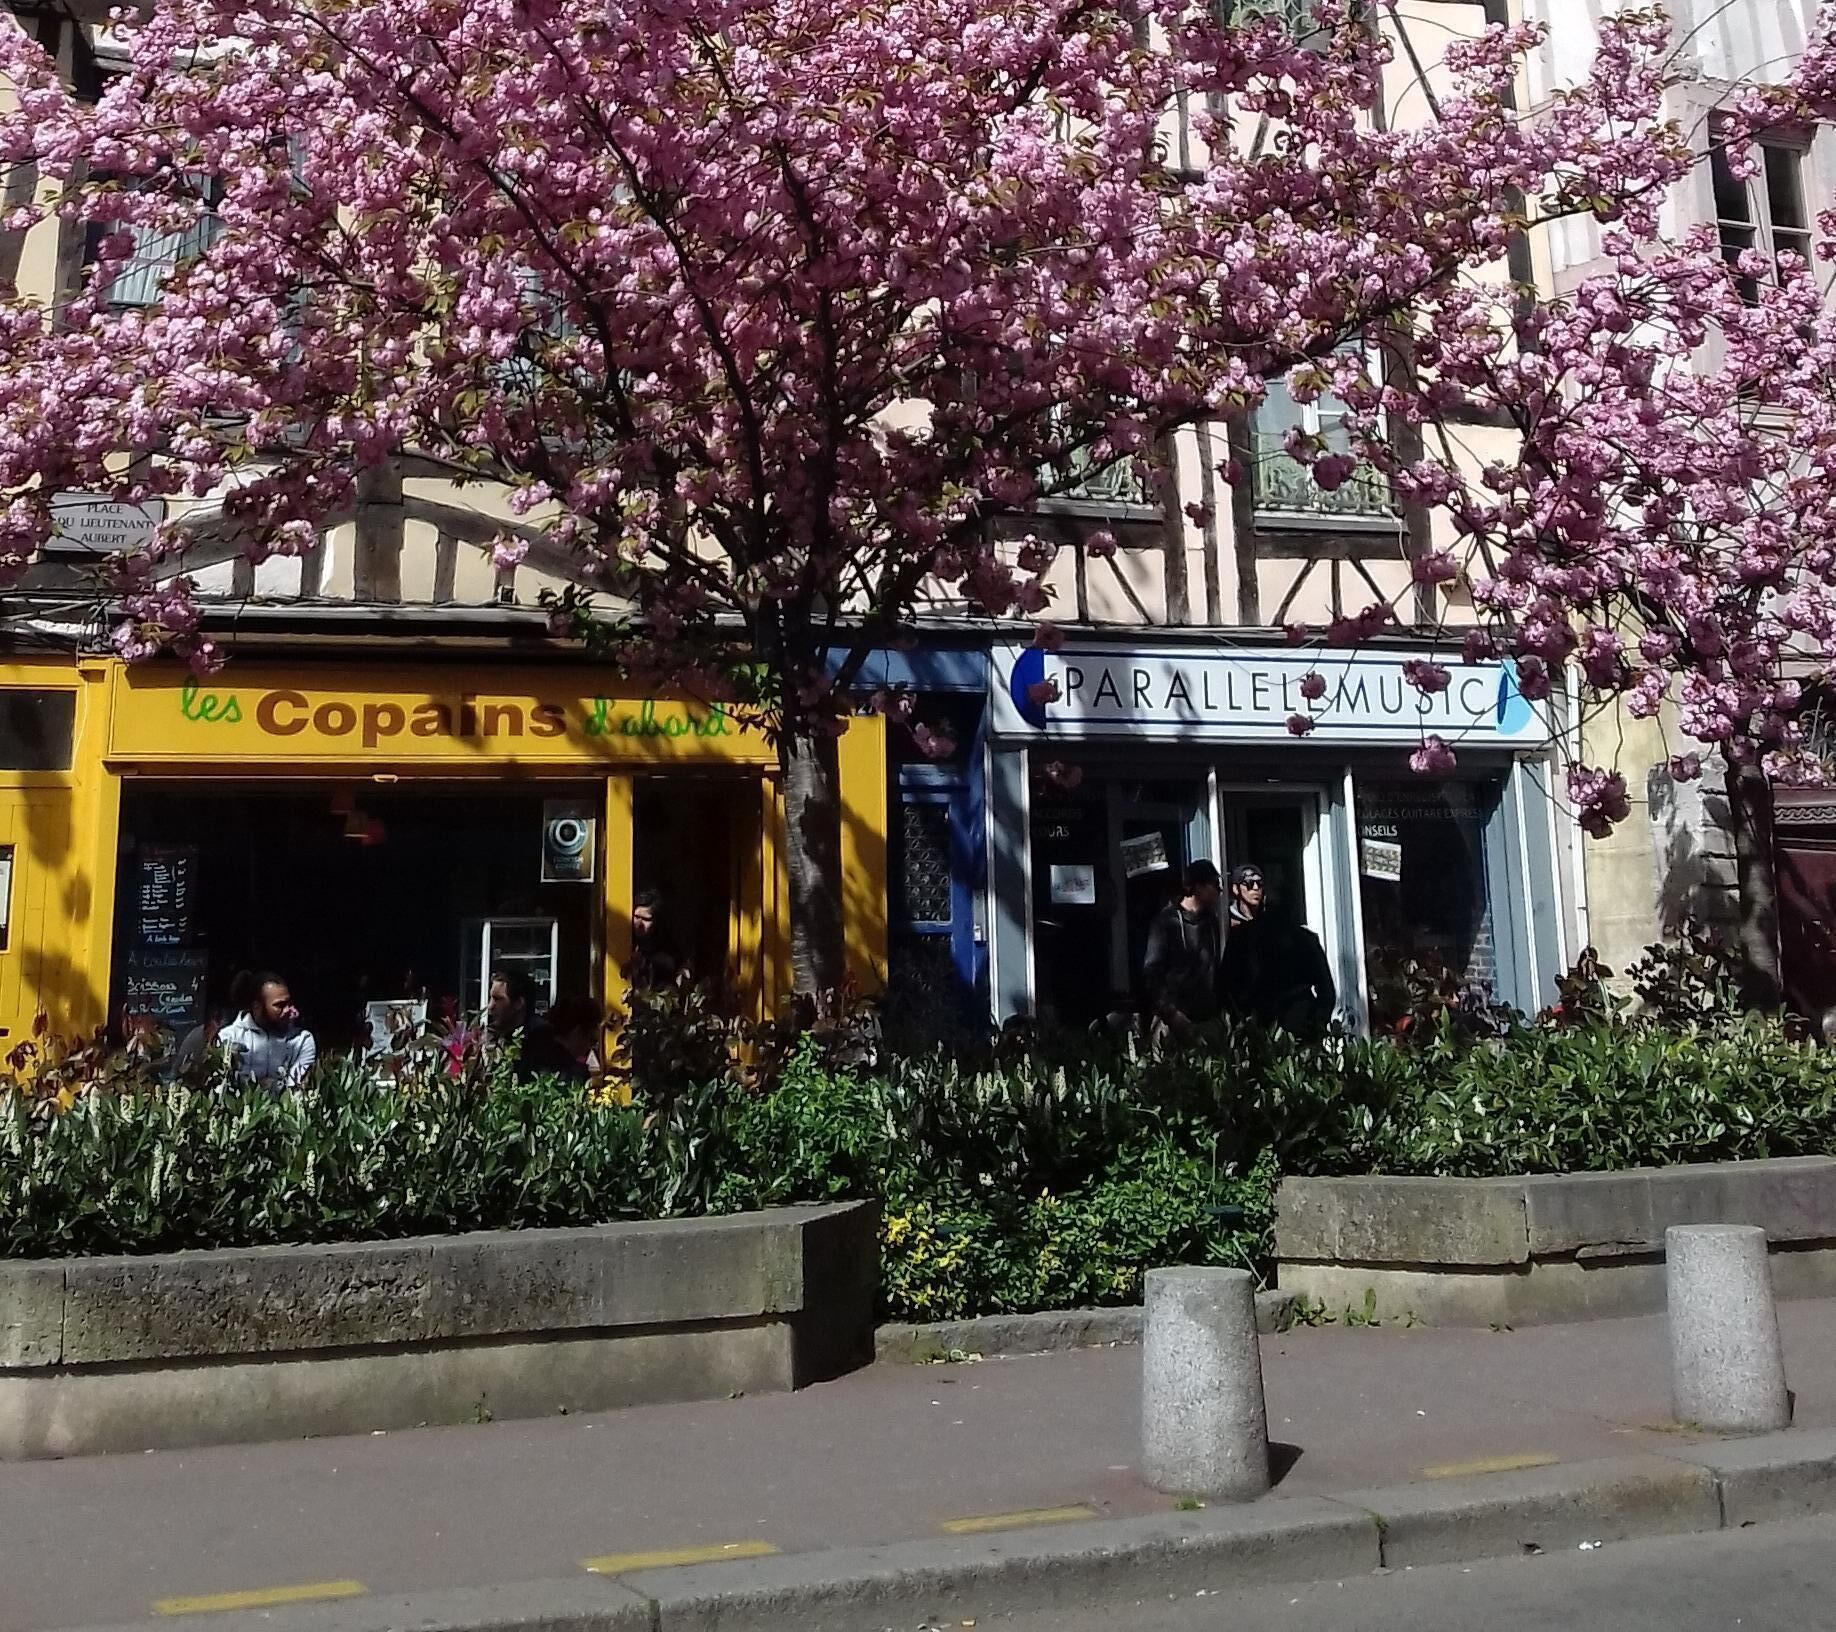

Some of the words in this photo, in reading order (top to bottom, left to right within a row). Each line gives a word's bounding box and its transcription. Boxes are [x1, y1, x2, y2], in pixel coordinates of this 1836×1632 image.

[87, 502, 124, 515] PLACE
[80, 517, 152, 529] LIEUTENANT
[80, 534, 127, 544] AUBERT
[180, 674, 243, 723] les
[255, 690, 567, 748] Copains
[584, 694, 731, 737] d'abord
